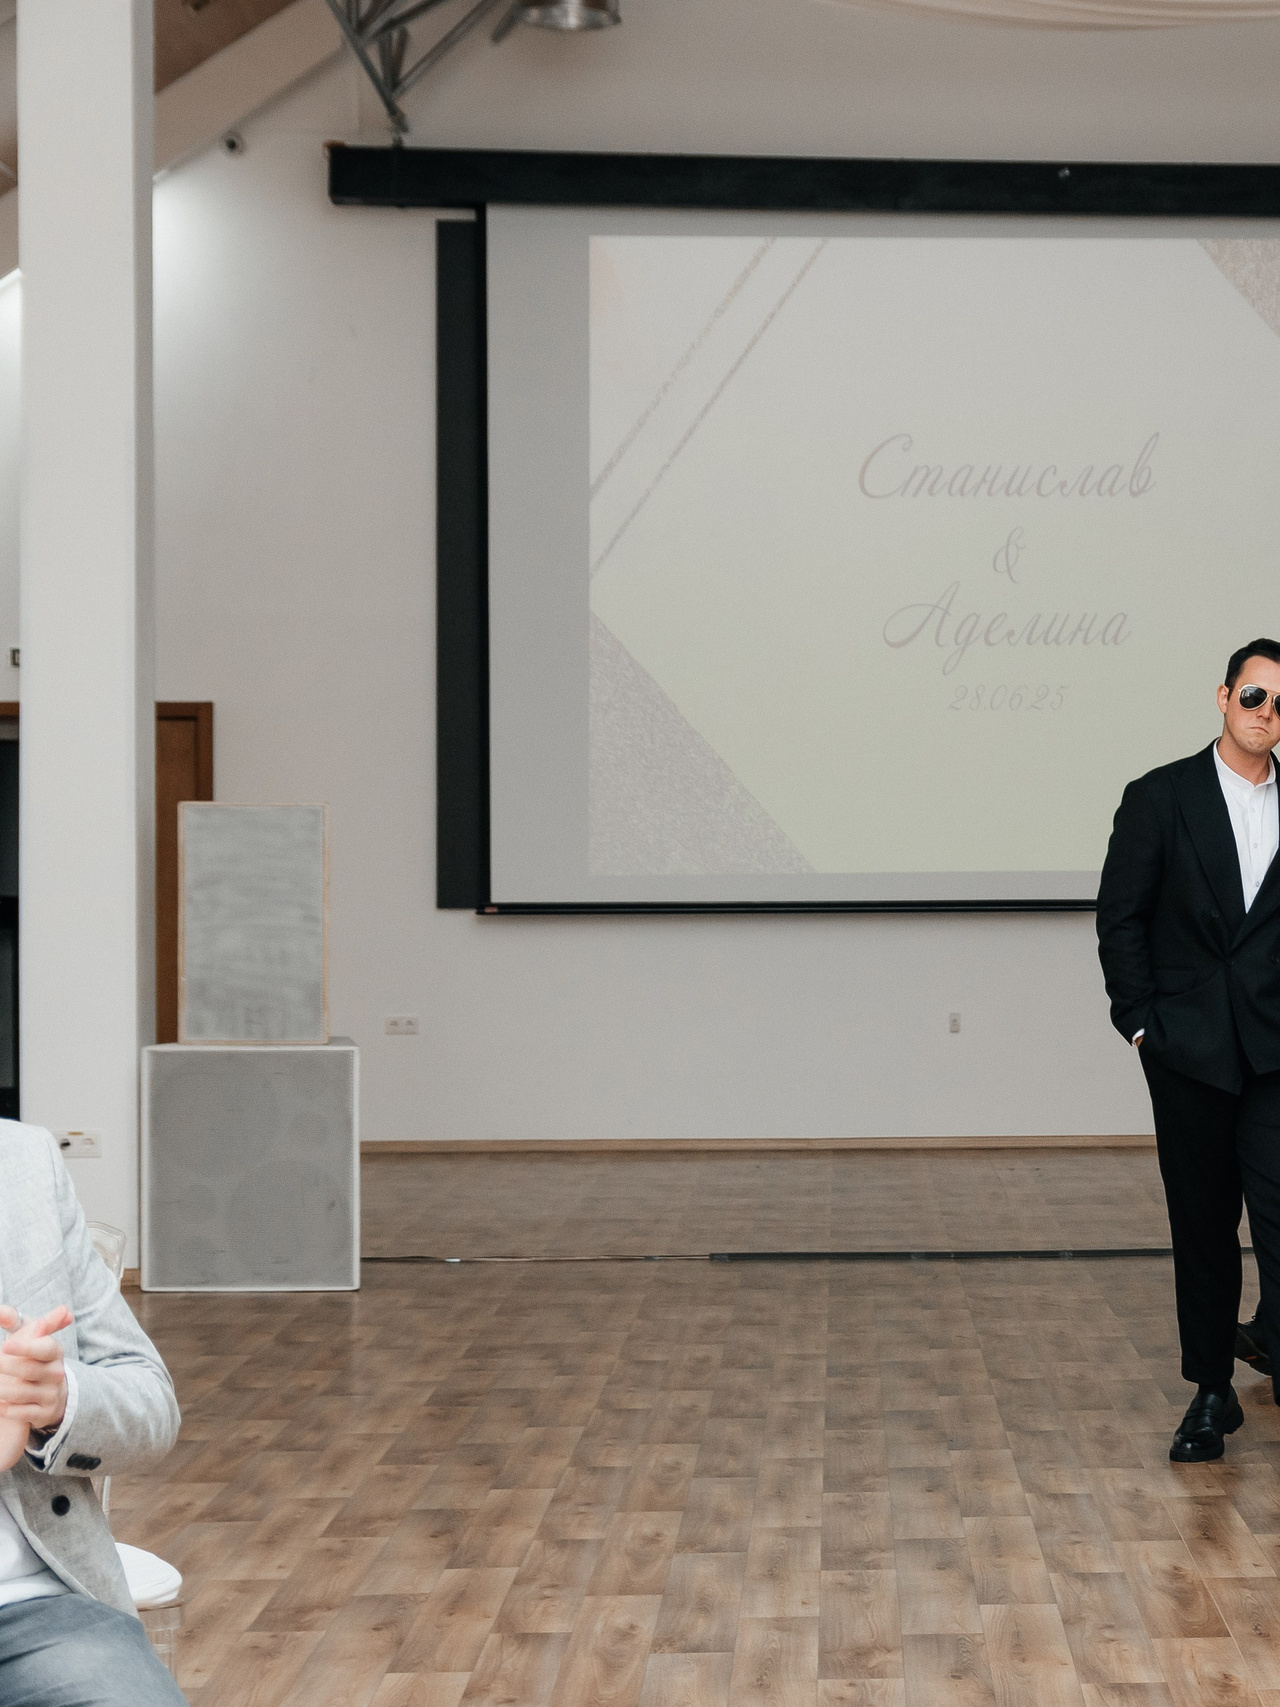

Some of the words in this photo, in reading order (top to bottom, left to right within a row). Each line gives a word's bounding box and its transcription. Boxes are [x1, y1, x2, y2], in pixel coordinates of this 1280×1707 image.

[858, 431, 1160, 499] Станислав
[992, 525, 1027, 584] &
[882, 580, 1132, 676] Аделина
